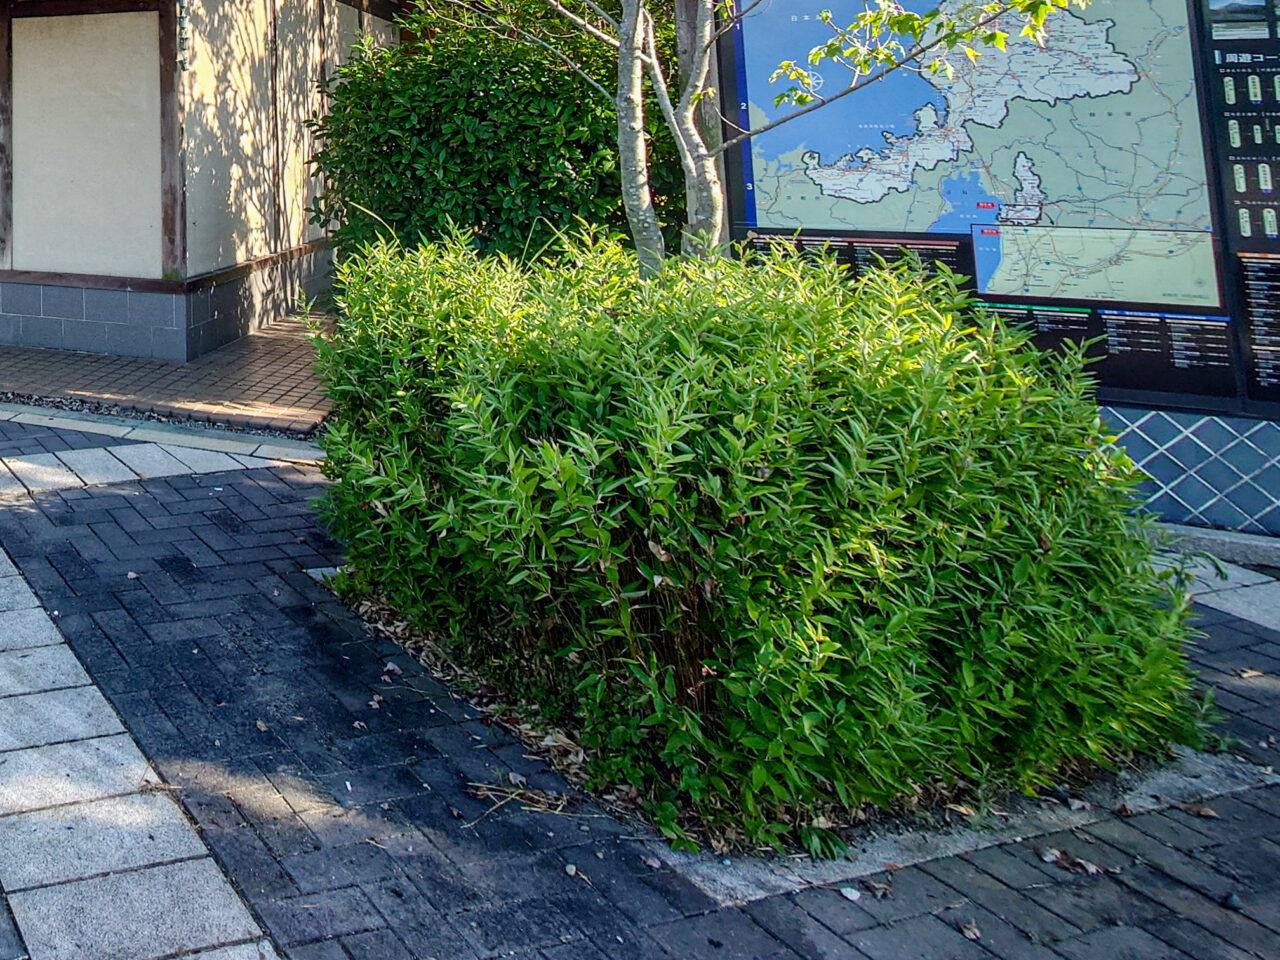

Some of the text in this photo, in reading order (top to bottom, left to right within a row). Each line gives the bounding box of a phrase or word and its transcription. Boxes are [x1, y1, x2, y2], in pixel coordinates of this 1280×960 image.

[1225, 53, 1280, 63] 周遊コー
[740, 102, 747, 110] 2
